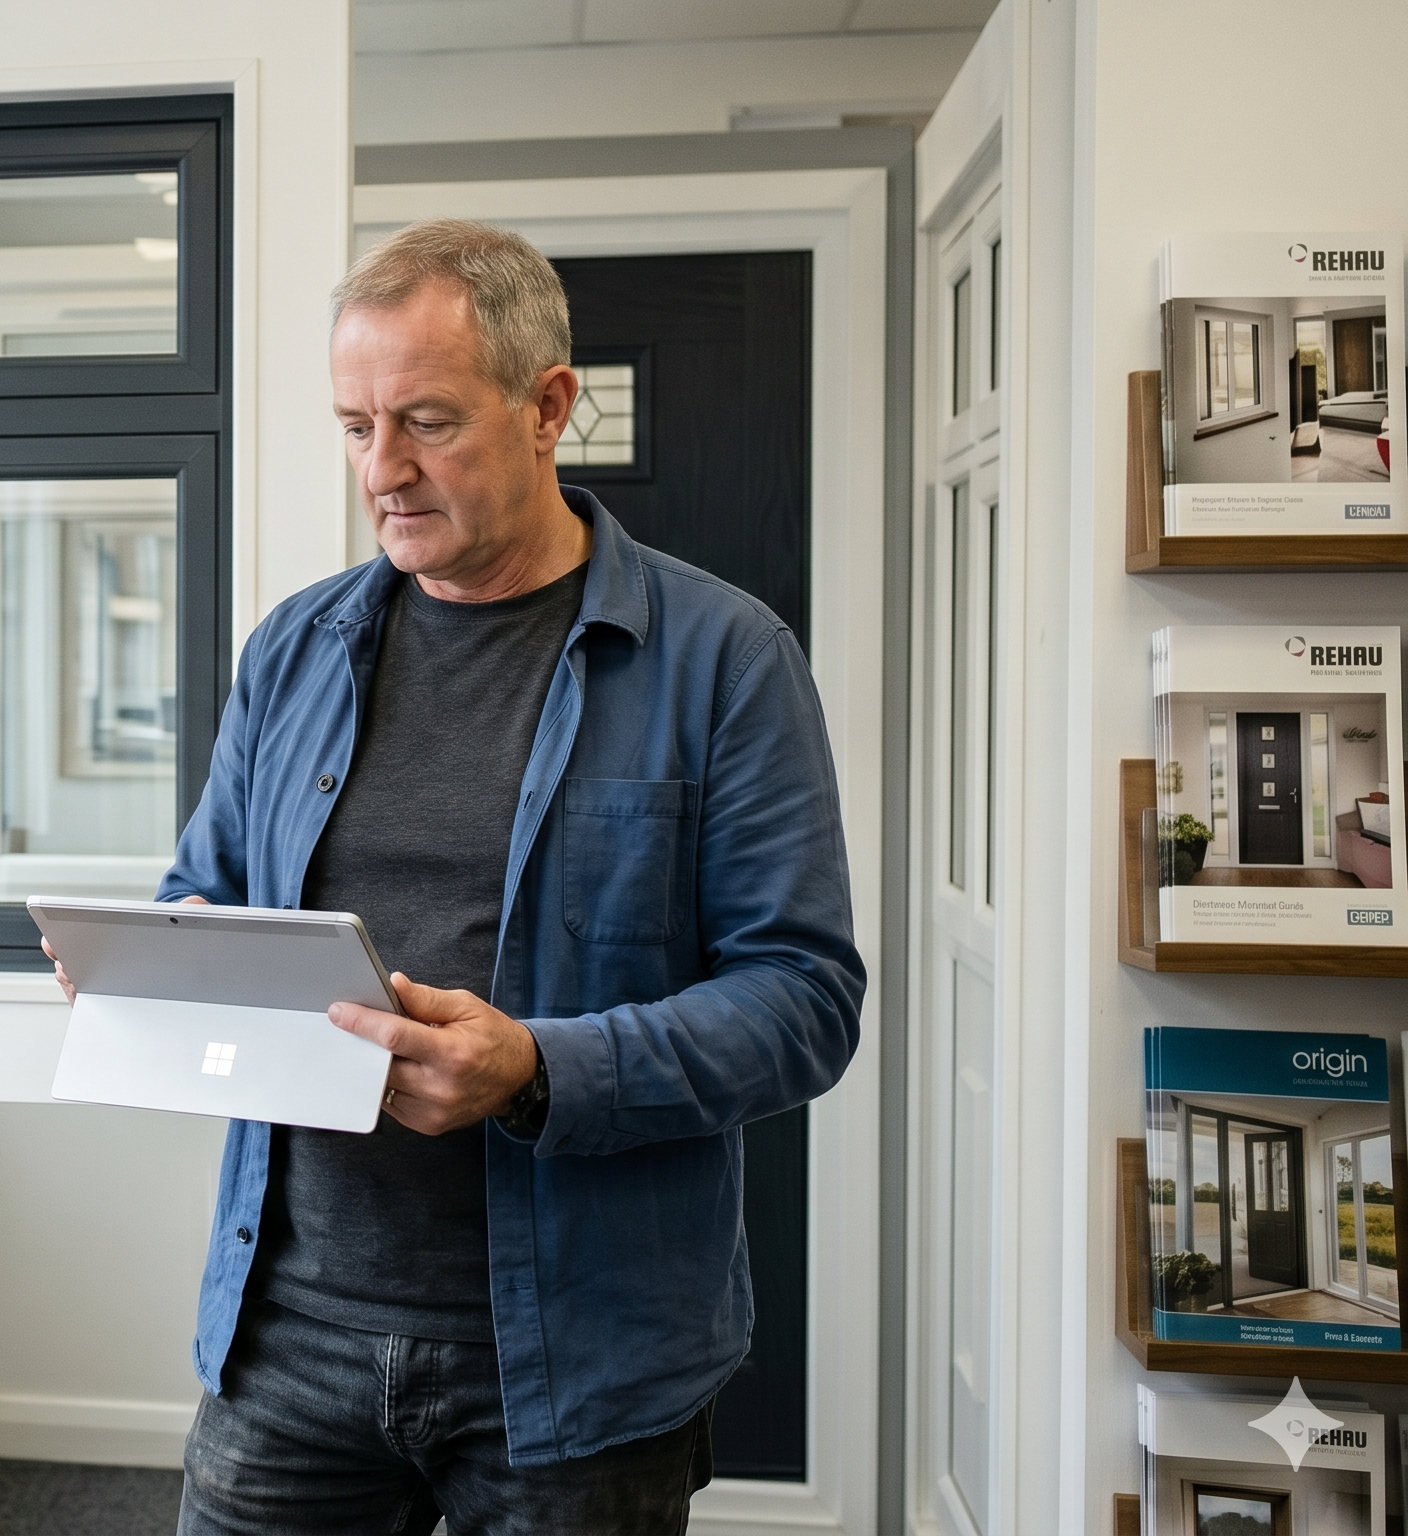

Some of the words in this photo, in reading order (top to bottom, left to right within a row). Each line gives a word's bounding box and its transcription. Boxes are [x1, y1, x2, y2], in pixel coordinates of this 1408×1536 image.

[1312, 250, 1385, 271] REHAU
[1311, 646, 1383, 666] REHAU
[1292, 1047, 1368, 1078] origin
[1308, 1427, 1367, 1448] REHAU
